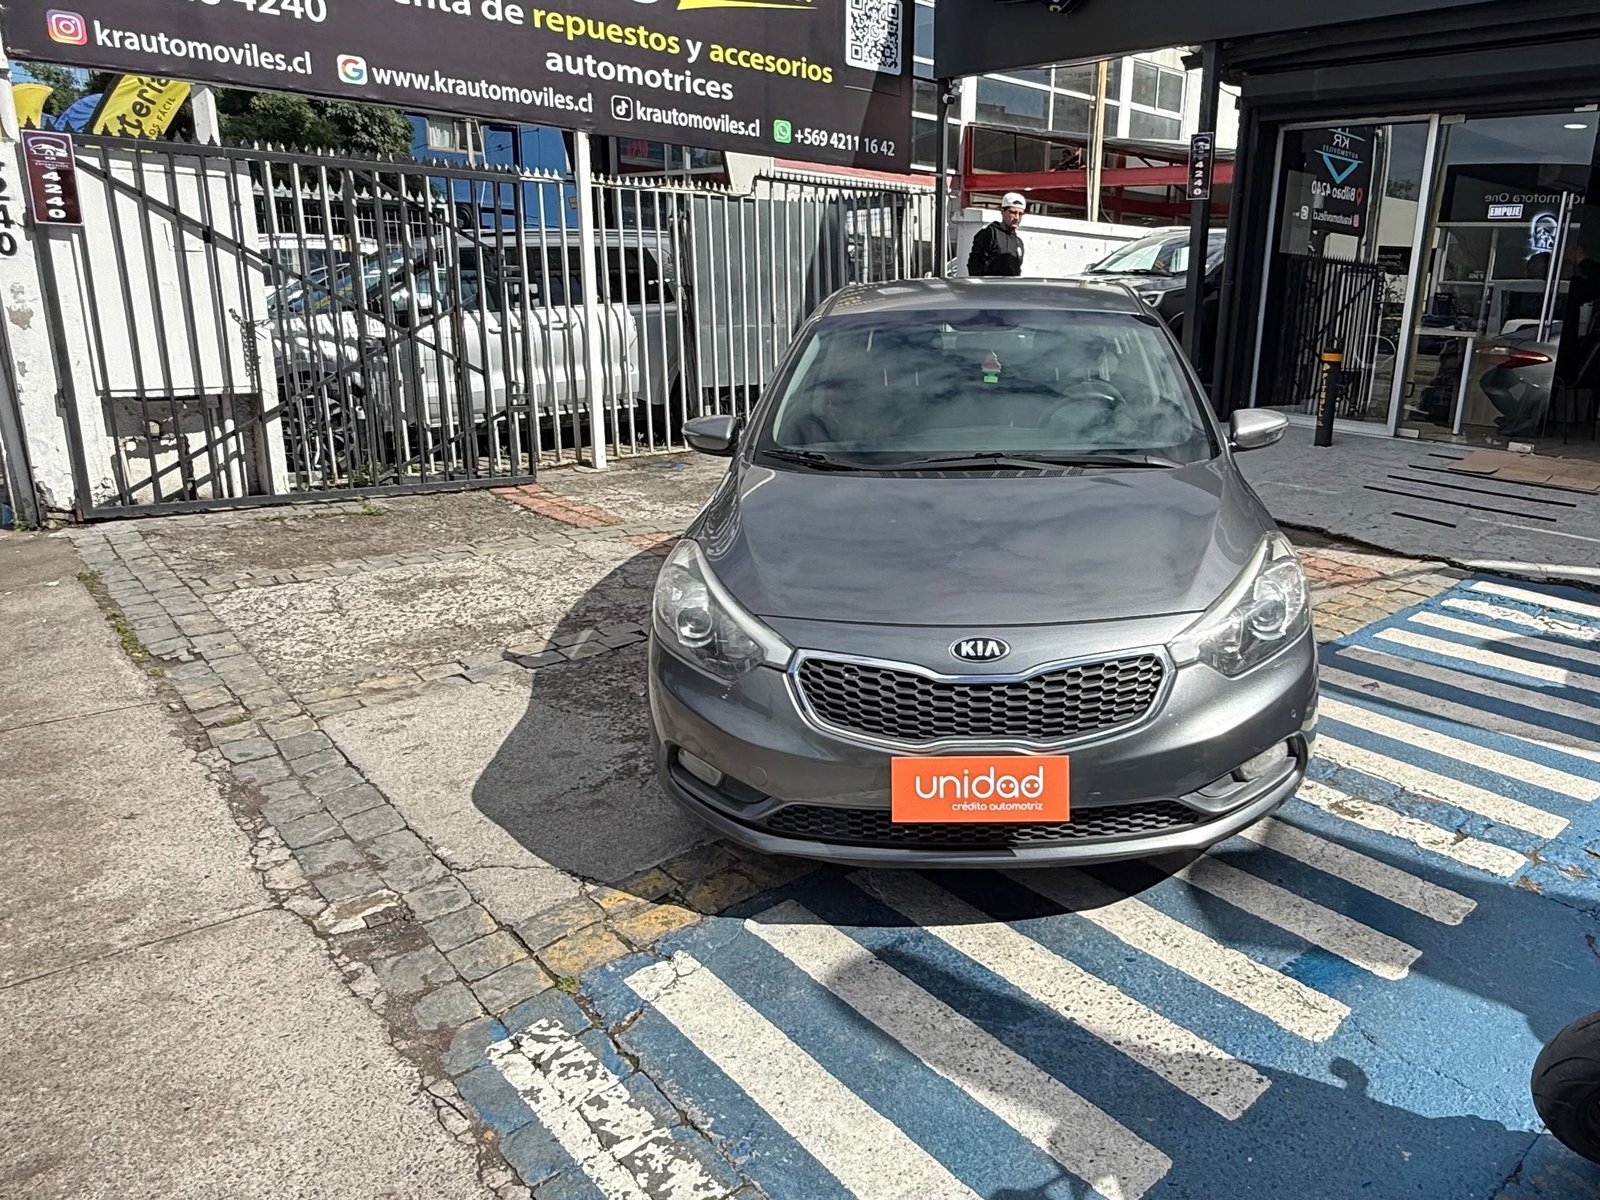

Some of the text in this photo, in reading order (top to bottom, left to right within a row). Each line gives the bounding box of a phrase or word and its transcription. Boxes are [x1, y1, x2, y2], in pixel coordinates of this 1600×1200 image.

[94, 20, 313, 75] krautomoviles.cl
[481, 0, 524, 25] de
[533, 8, 681, 54] repuestos
[685, 39, 702, 64] y
[709, 44, 833, 84] accesorios
[372, 67, 594, 113] www.krautomoviles.cl
[545, 51, 734, 100] automotrices
[636, 100, 760, 138] krautomoviles.cl
[795, 128, 895, 157] +569 4211 16 42
[43, 171, 66, 219] 4240
[1193, 161, 1204, 195] 4240
[1489, 206, 1521, 217] EMPUJE
[961, 640, 1001, 657] KIA
[915, 765, 1044, 799] unidad
[951, 802, 1043, 811] crédito automotriz
